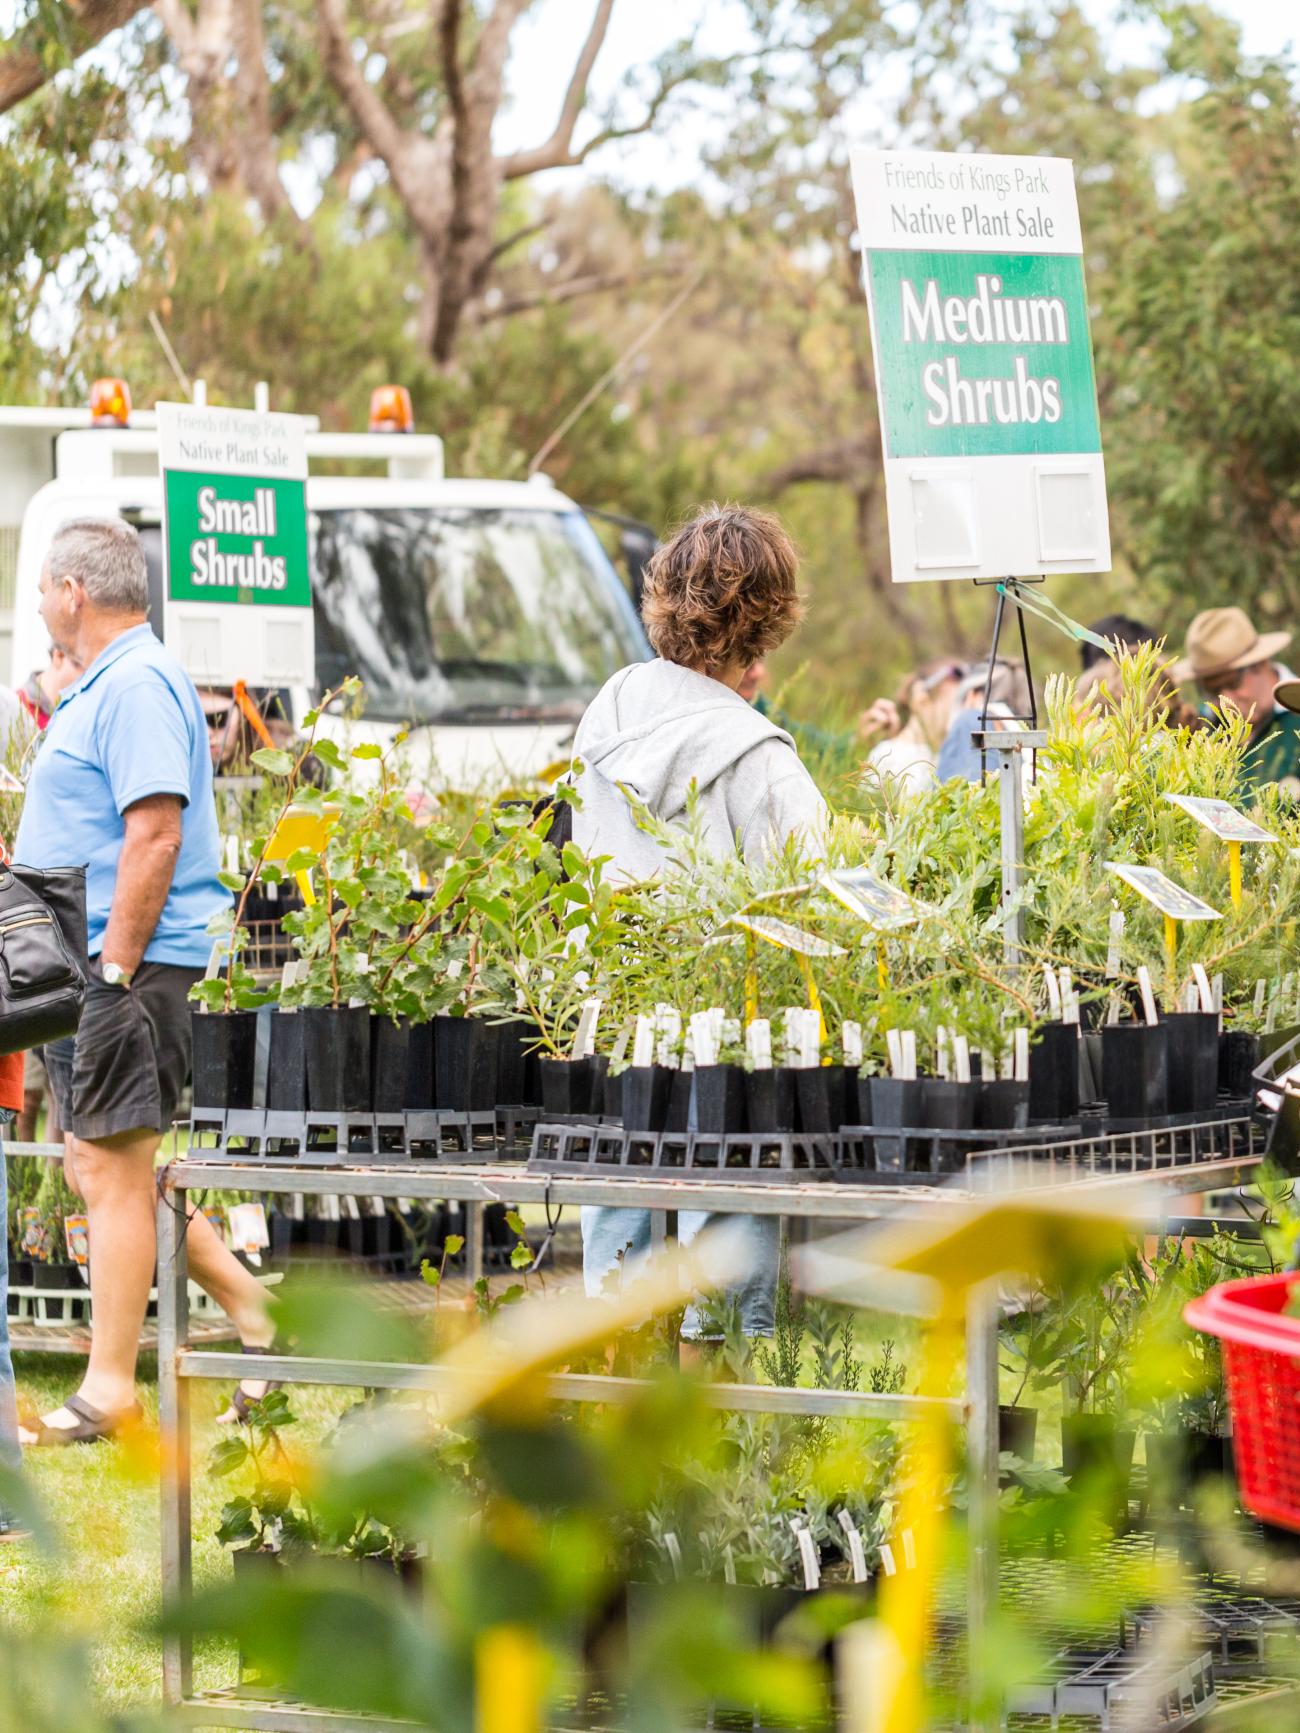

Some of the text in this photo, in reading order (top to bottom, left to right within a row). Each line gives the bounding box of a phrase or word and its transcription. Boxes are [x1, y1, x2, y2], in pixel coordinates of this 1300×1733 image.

[884, 162, 1050, 201] Friends of Kings Park
[890, 203, 1055, 238] Native Plant Sale
[900, 274, 1069, 344] Medium
[922, 356, 1062, 426] Shrubs
[178, 439, 289, 469] Native Plant Sale
[198, 486, 276, 537] Small
[190, 537, 287, 590] Shrubs
